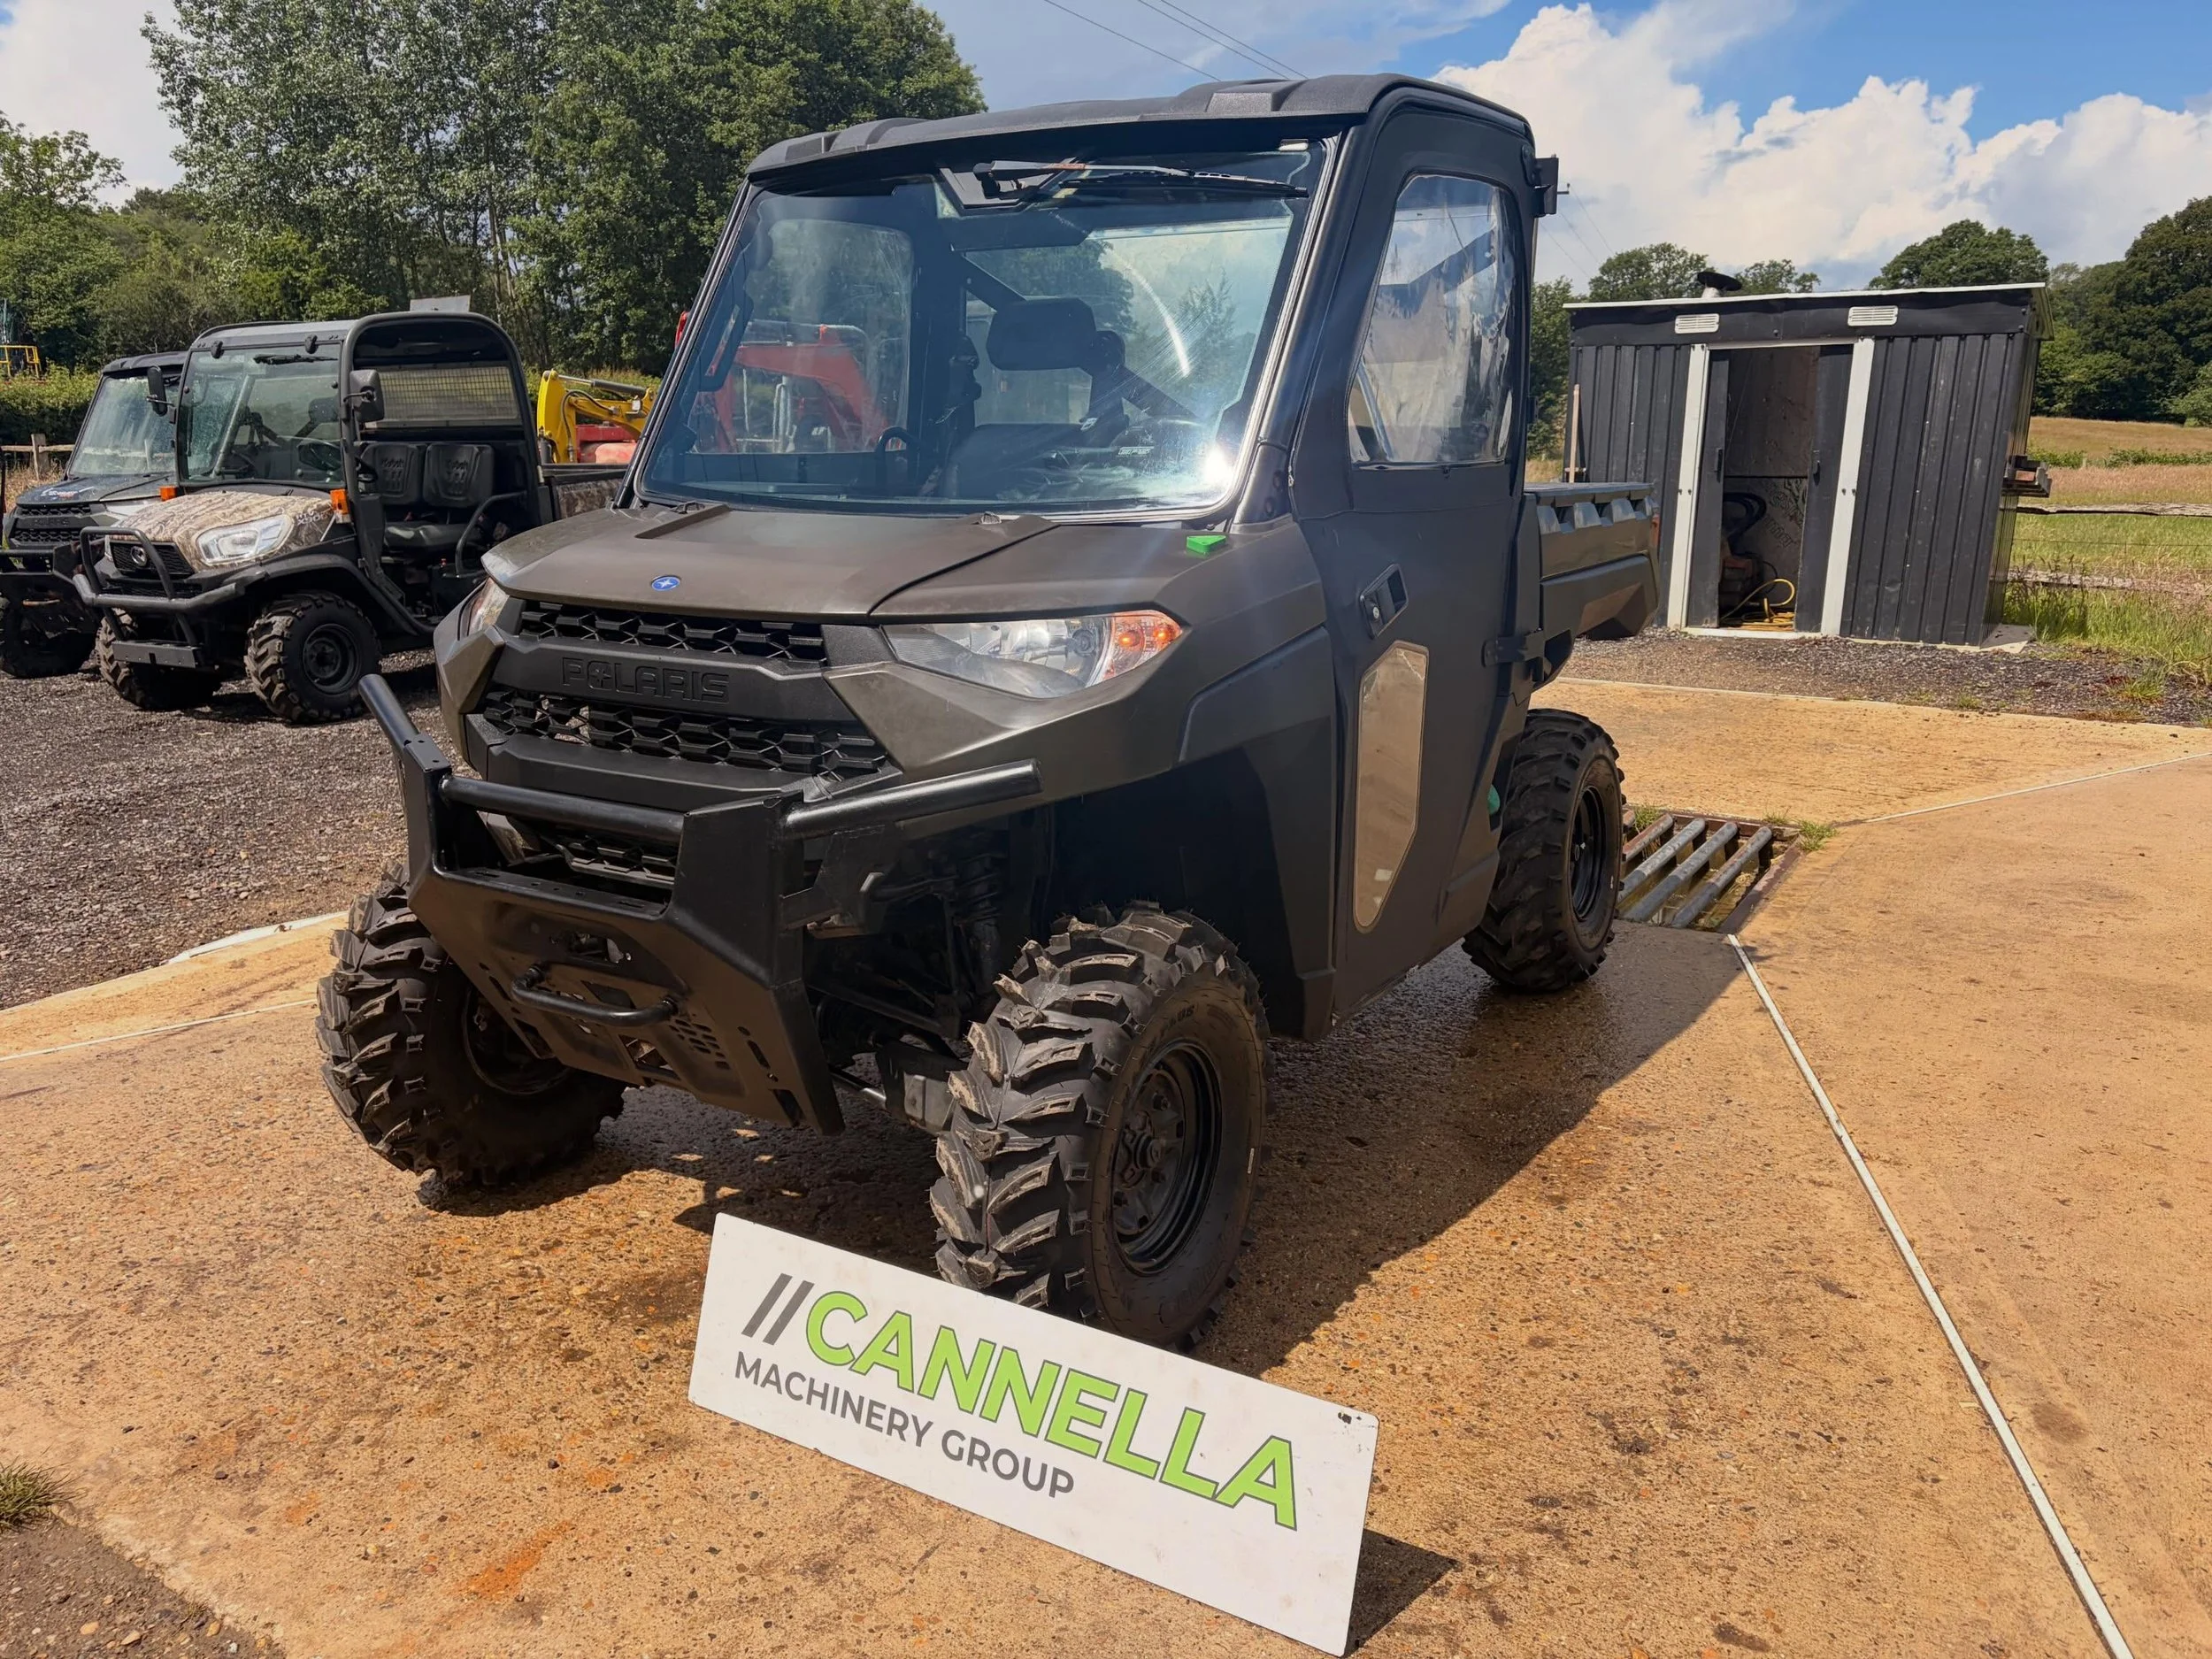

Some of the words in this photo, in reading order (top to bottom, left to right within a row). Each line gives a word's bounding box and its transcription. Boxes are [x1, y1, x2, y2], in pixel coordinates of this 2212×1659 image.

[562, 657, 729, 704] POLARIS
[734, 1351, 933, 1448] MACHINERY
[941, 1429, 1074, 1498] GROUP
